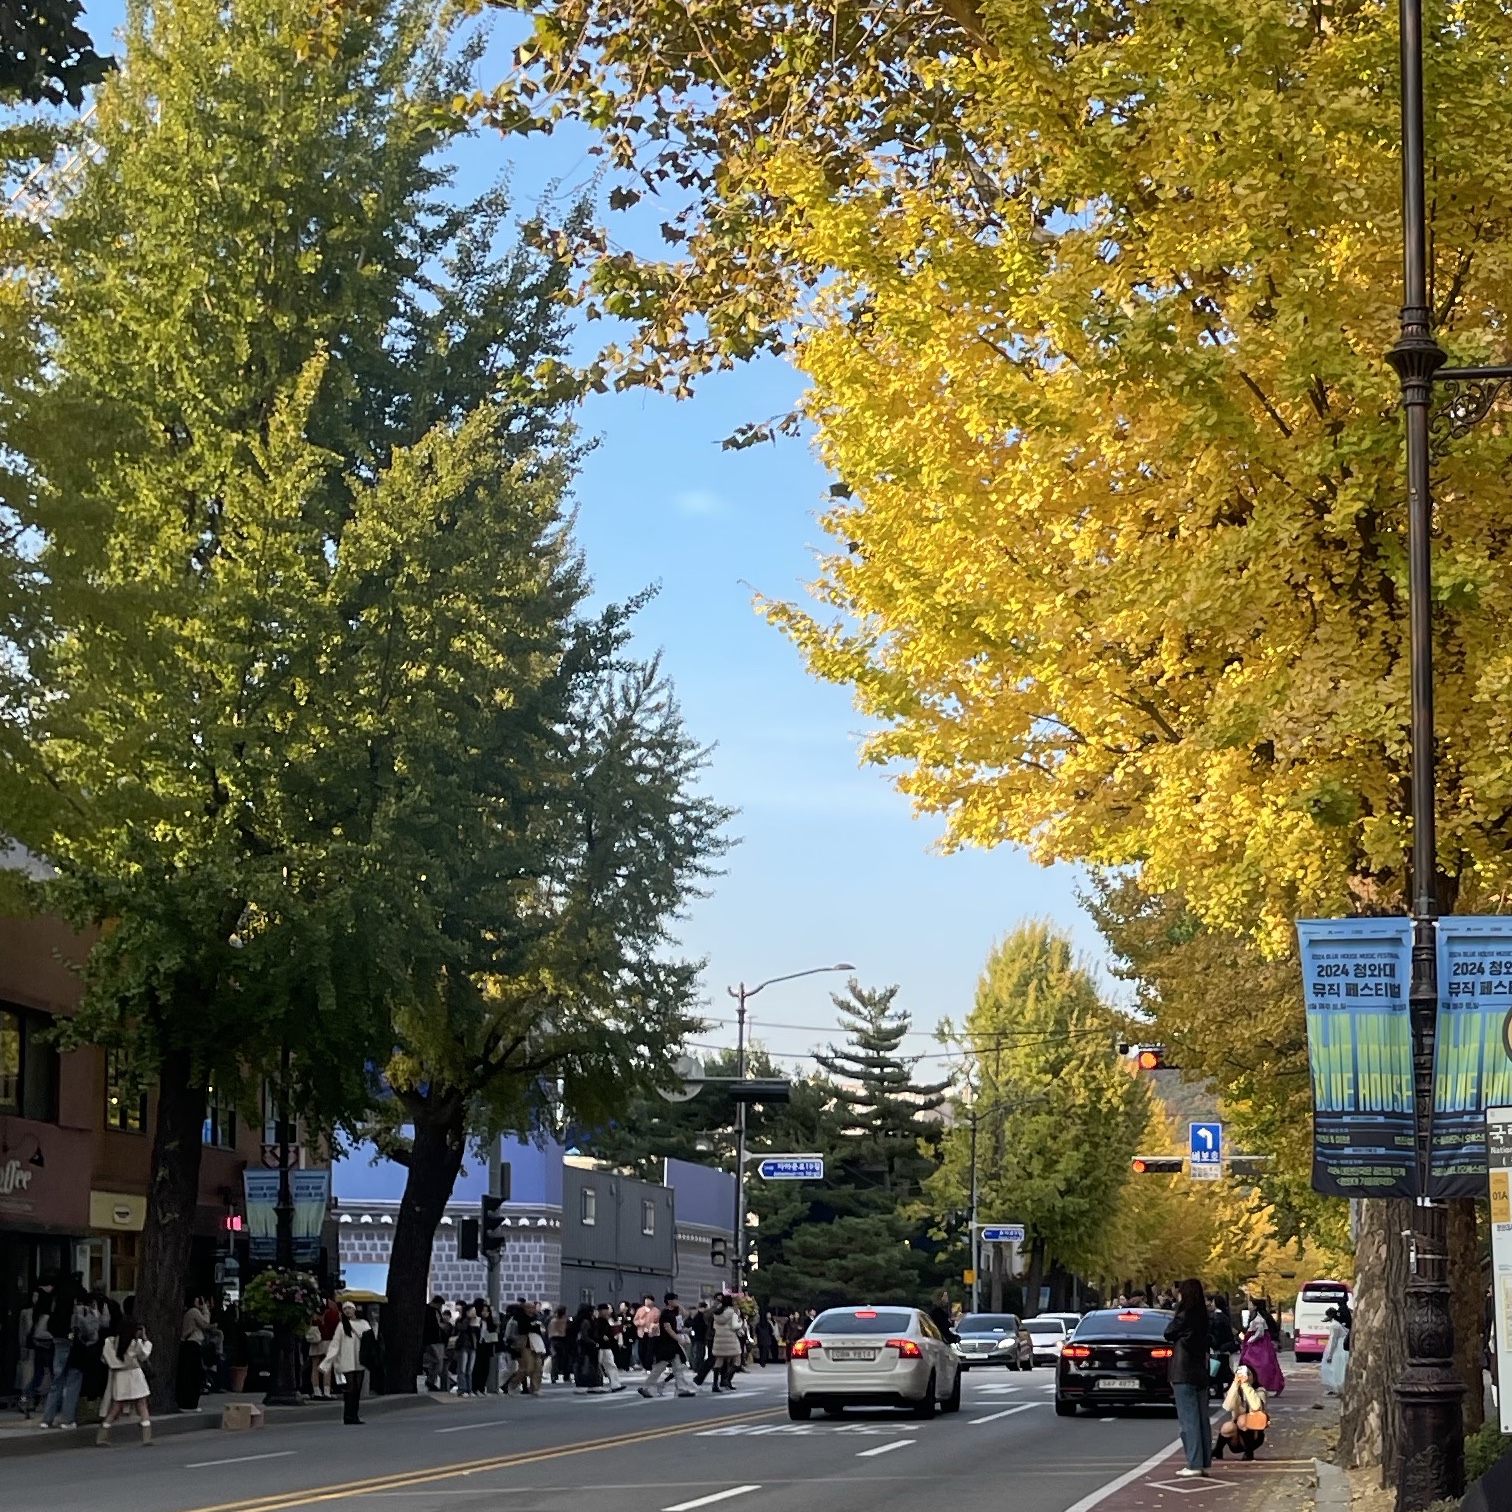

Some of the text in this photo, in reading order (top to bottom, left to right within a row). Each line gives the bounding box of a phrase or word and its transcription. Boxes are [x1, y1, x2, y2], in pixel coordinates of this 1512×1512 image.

[1316, 962, 1396, 979] 2024 청와대
[1452, 961, 1486, 976] 2024
[1312, 982, 1401, 999] 뮤직 페스티벌
[1448, 981, 1475, 997] 뮤직
[1359, 1073, 1413, 1113] HOUSE
[1434, 1072, 1478, 1112] BLUE
[1191, 1151, 1219, 1162] 비보호
